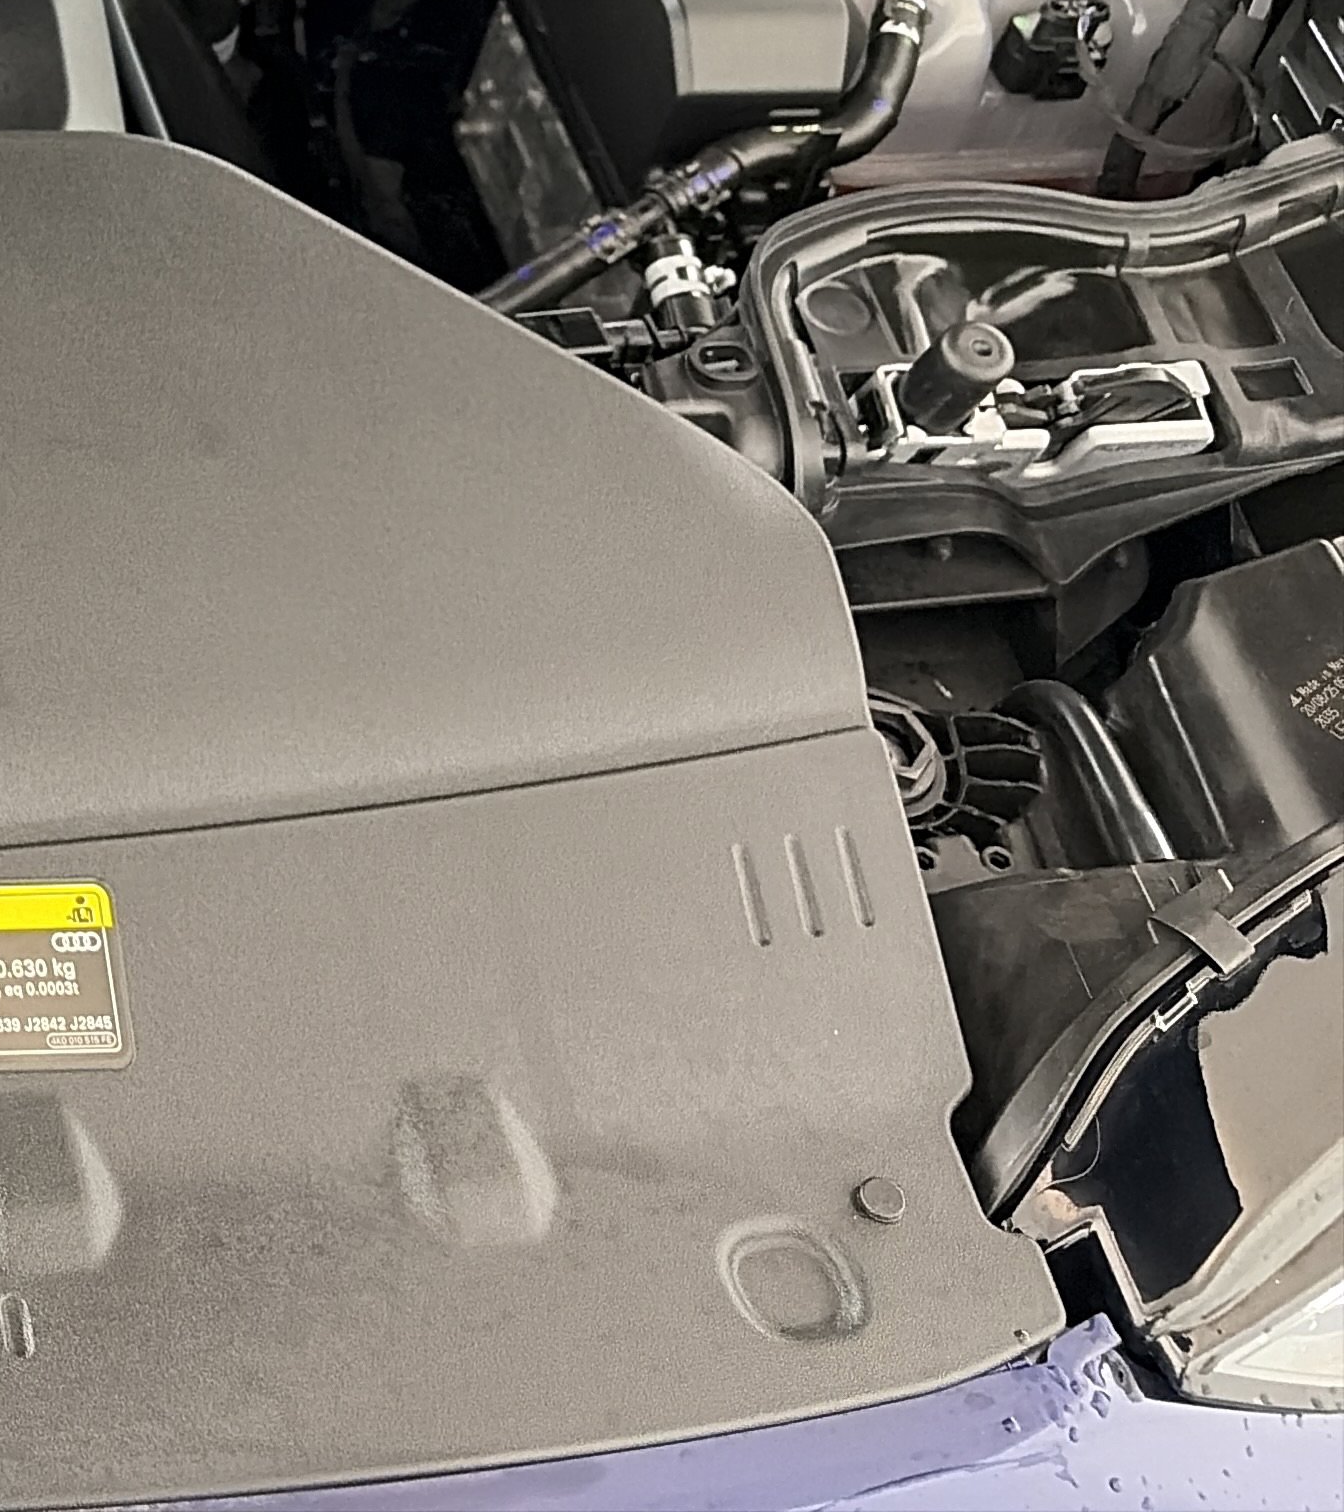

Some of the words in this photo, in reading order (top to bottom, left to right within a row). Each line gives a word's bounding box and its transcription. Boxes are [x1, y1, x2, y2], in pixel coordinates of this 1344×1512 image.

[51, 957, 76, 980] kg
[4, 984, 24, 999] eq
[25, 981, 80, 997] 0.0003t
[24, 1016, 67, 1032] J2842
[70, 1015, 113, 1031] J2845
